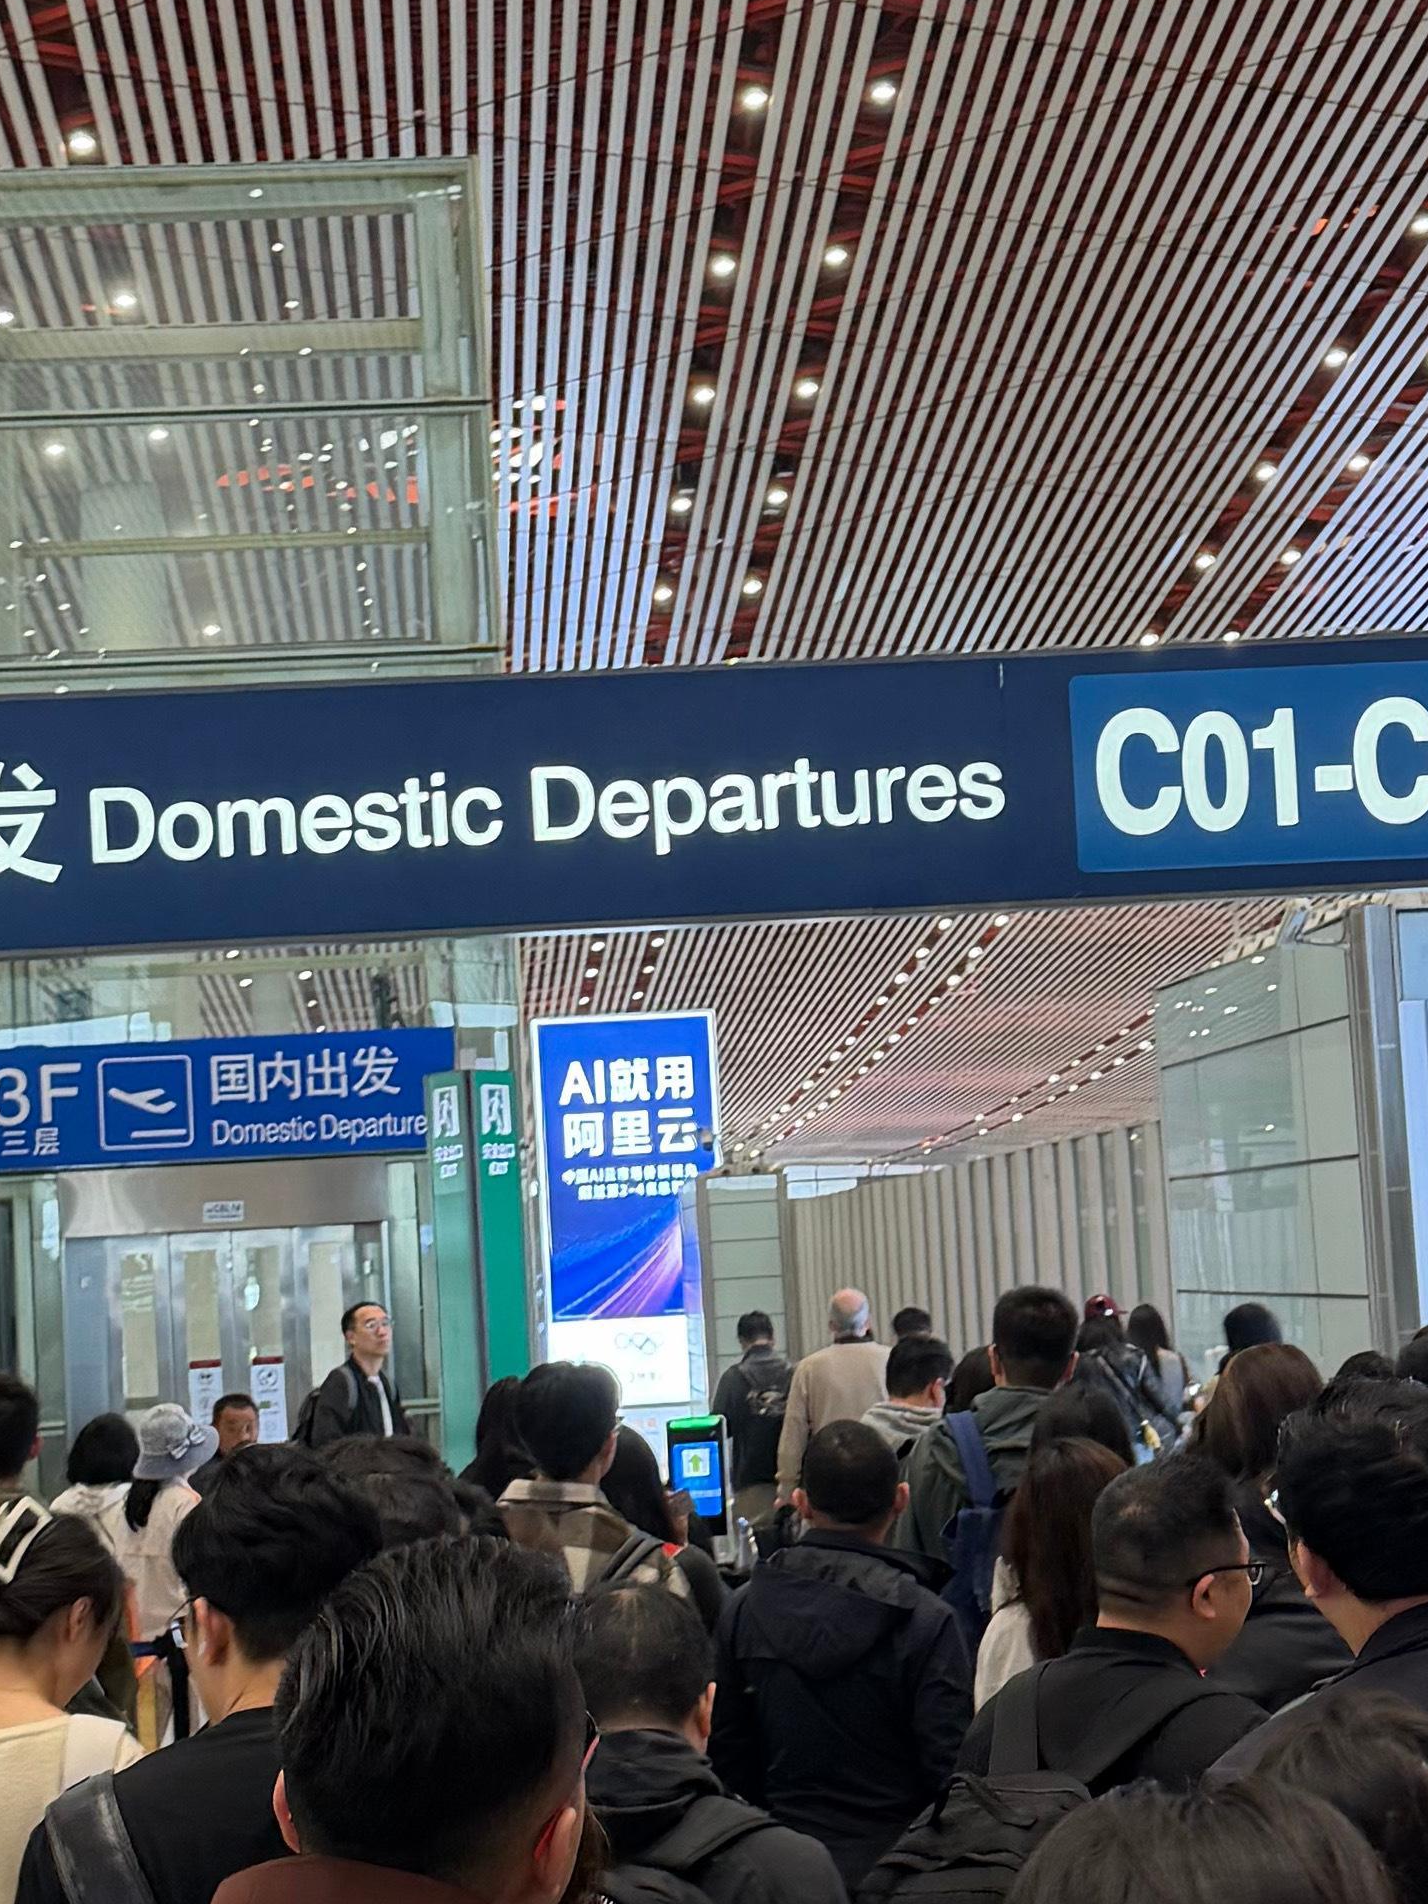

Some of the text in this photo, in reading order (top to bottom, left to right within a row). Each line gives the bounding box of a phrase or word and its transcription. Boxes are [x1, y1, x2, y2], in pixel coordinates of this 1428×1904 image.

[90, 772, 503, 863] Domestic
[531, 758, 1005, 855] Departures
[210, 1045, 400, 1105] 国内出发
[558, 1055, 694, 1106] AI就用
[2, 1128, 60, 1156] 三层
[212, 1116, 315, 1146] Domestic
[562, 1107, 697, 1159] 阿里云
